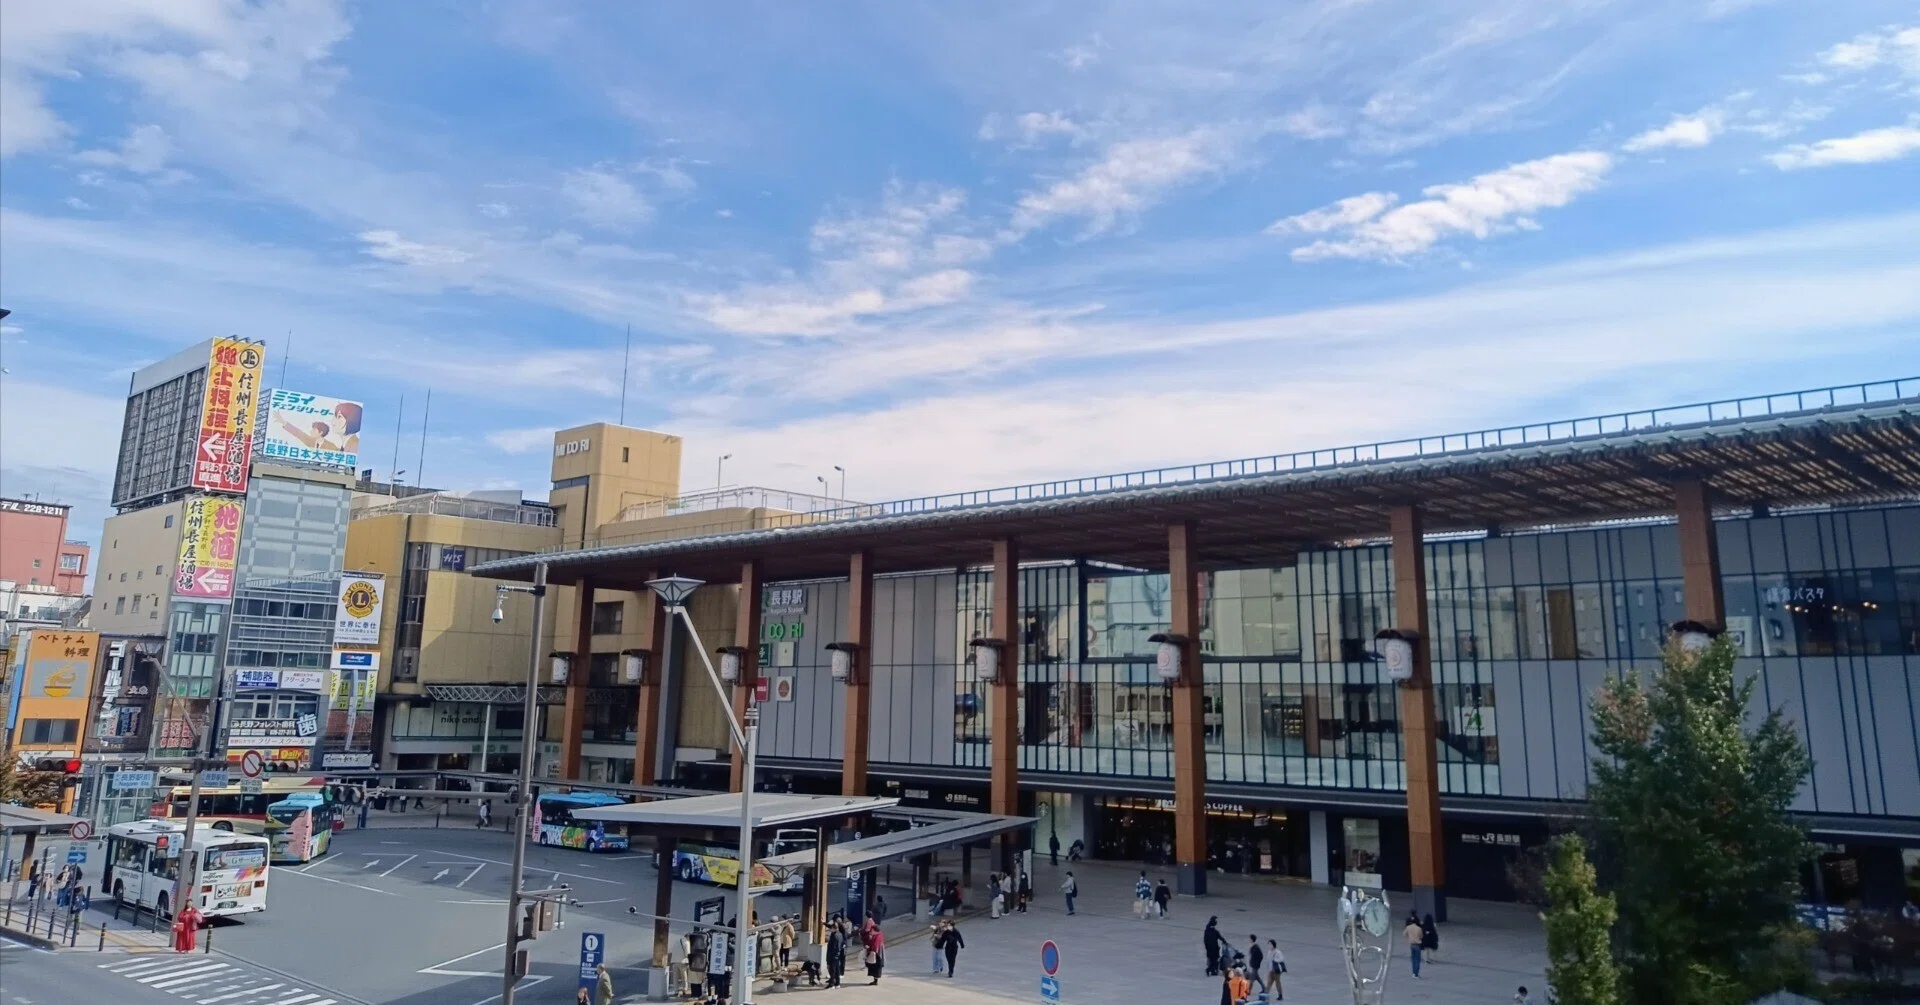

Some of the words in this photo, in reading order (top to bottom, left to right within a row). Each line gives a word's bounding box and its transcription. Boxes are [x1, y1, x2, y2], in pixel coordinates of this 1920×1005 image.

[206, 346, 237, 428] 郷土料理
[272, 390, 315, 404] ミライ
[226, 372, 254, 485] 信州長屋酒場
[266, 444, 356, 465] 長野日本大学学園
[24, 504, 63, 516] 228-1211
[178, 501, 204, 589] 信州長屋酒場
[351, 583, 373, 592] LIONS
[356, 592, 366, 605] L
[772, 589, 802, 605] 長野駅
[340, 621, 377, 629] 世界に奉仕
[38, 634, 85, 644] ベトナム
[64, 647, 90, 657] 料理
[242, 671, 273, 681] 補聴器
[296, 714, 317, 737] 歯
[281, 749, 302, 760] Daily
[121, 773, 150, 781] 長野駅前
[1212, 802, 1244, 811] COFFEE
[1482, 833, 1495, 843] JR
